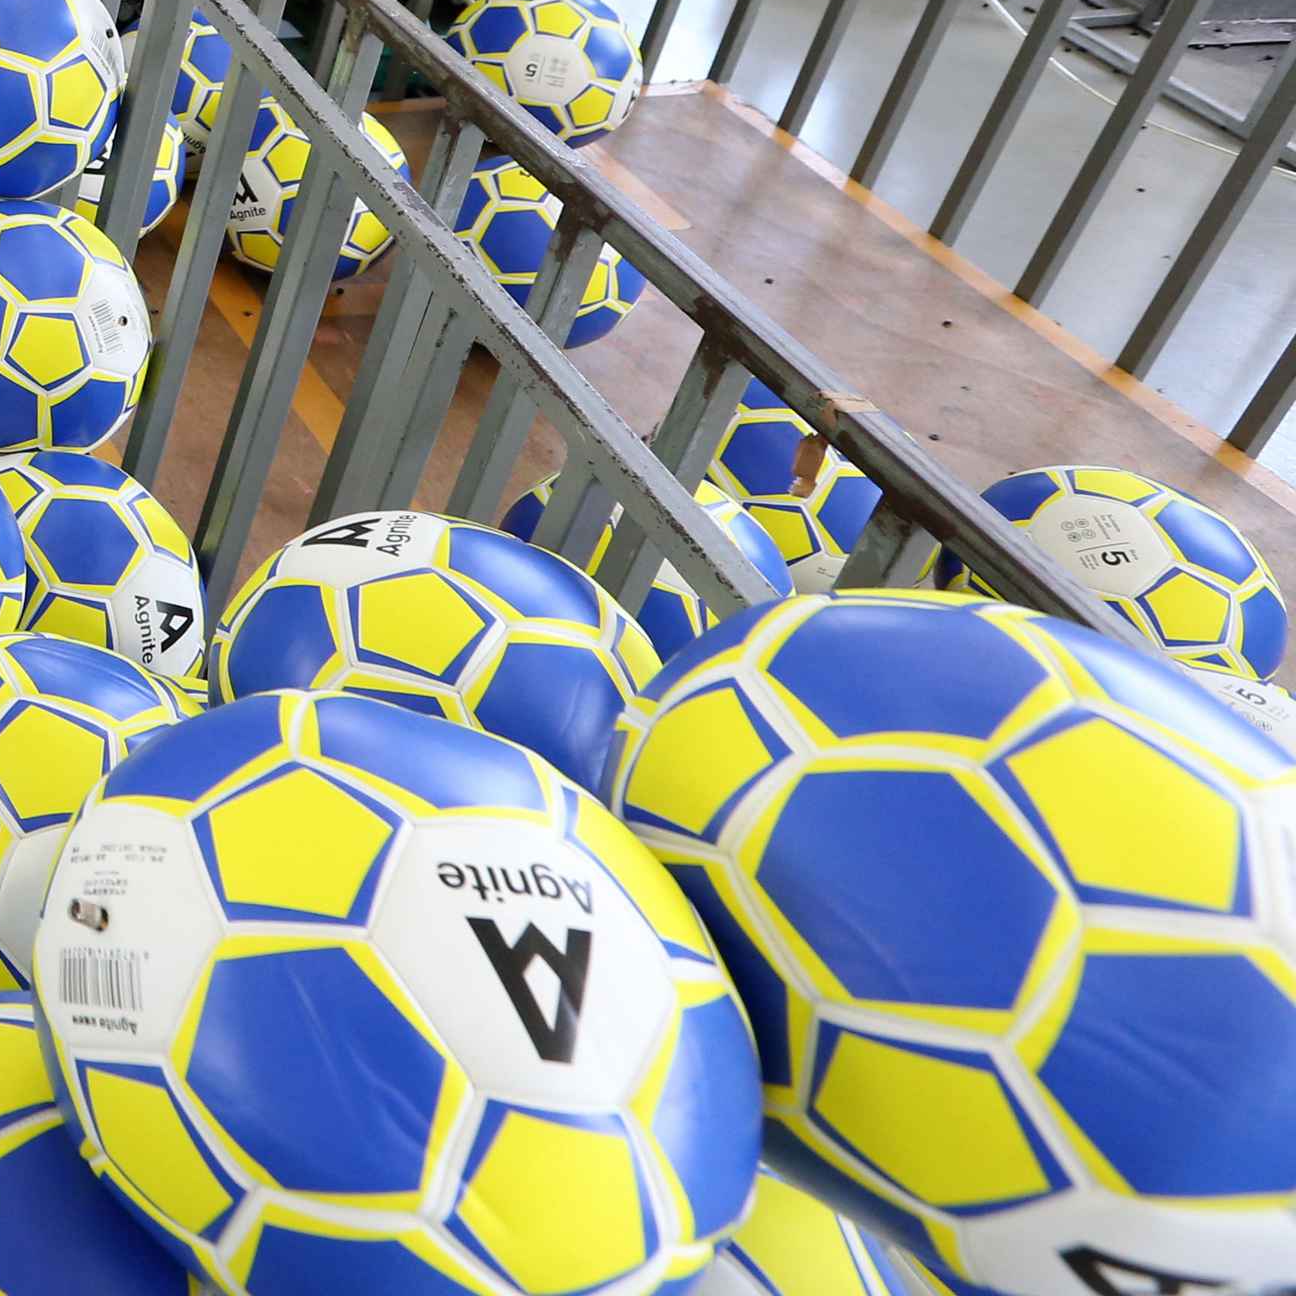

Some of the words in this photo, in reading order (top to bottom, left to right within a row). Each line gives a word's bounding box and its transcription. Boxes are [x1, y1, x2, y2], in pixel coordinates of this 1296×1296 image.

[229, 206, 266, 221] Agnite
[376, 513, 418, 557] Agnite
[1101, 551, 1131, 566] 5
[134, 594, 154, 664] Agnite
[1235, 688, 1267, 705] 5
[436, 860, 594, 915] Agnite
